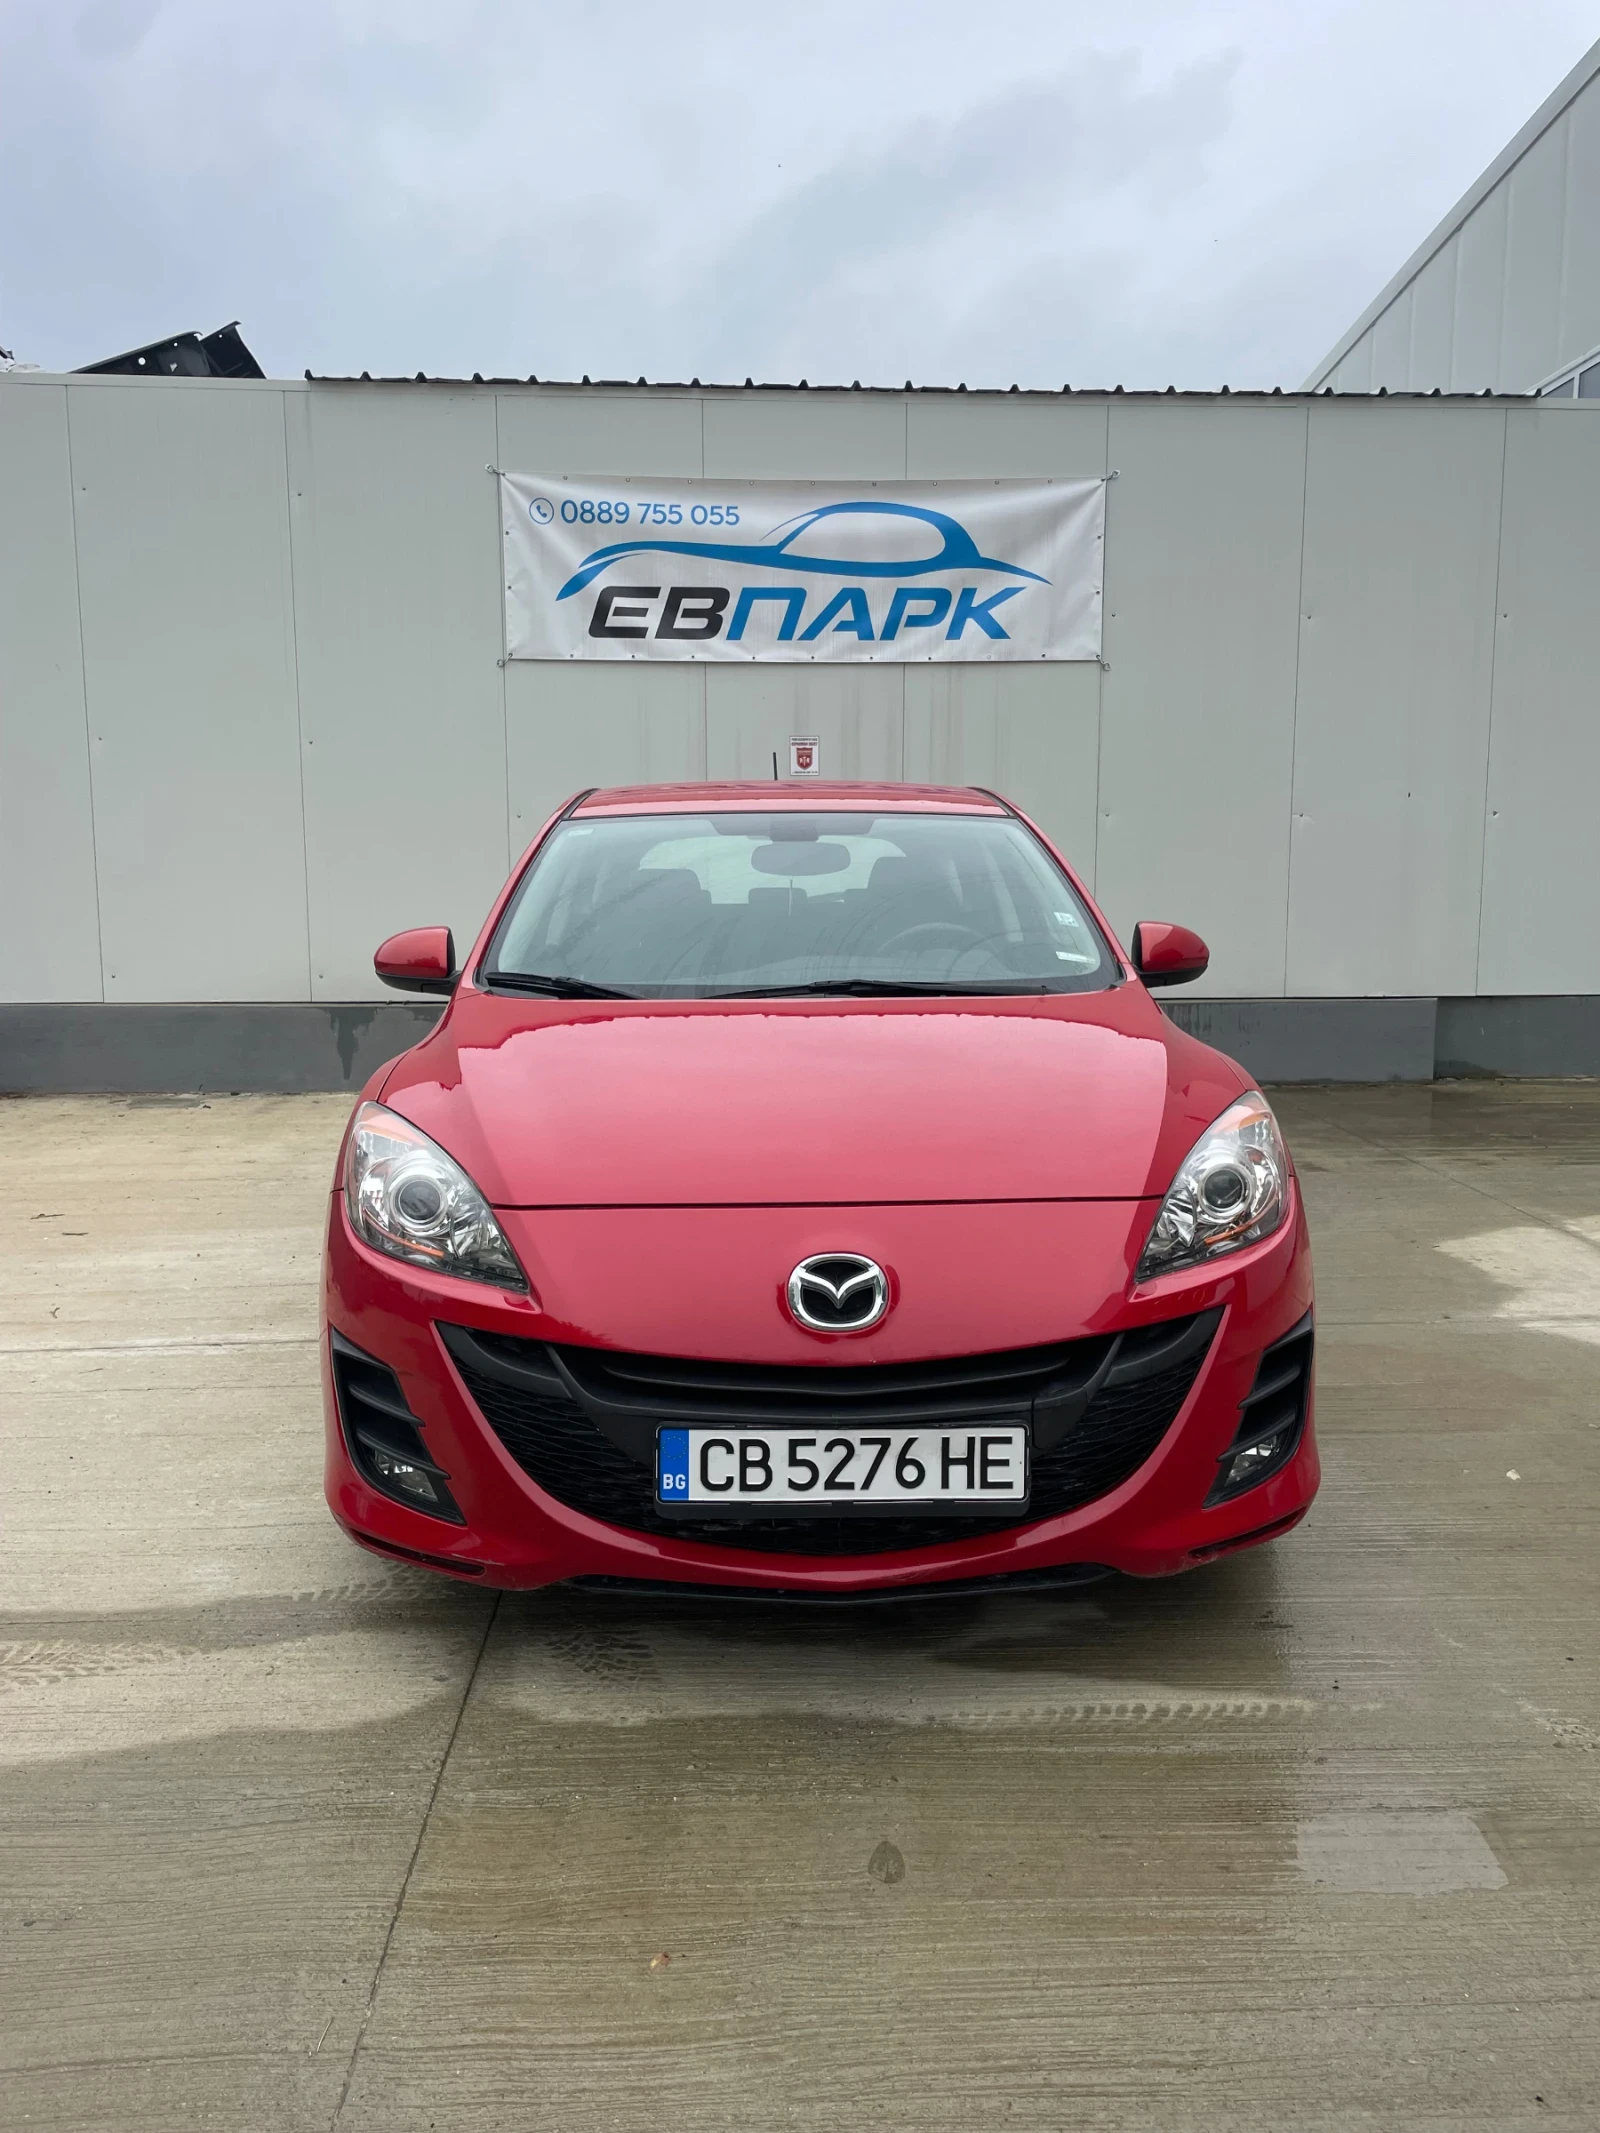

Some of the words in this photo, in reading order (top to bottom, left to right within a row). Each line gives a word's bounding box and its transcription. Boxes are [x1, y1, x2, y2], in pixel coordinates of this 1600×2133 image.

[560, 499, 630, 525] 0889
[637, 502, 683, 525] 755
[691, 504, 740, 527] 055
[588, 586, 1027, 641] ЕВПАРК
[663, 1473, 686, 1490] BG
[699, 1437, 773, 1491] CB
[787, 1437, 926, 1490] 5276
[940, 1436, 1014, 1489] HE
